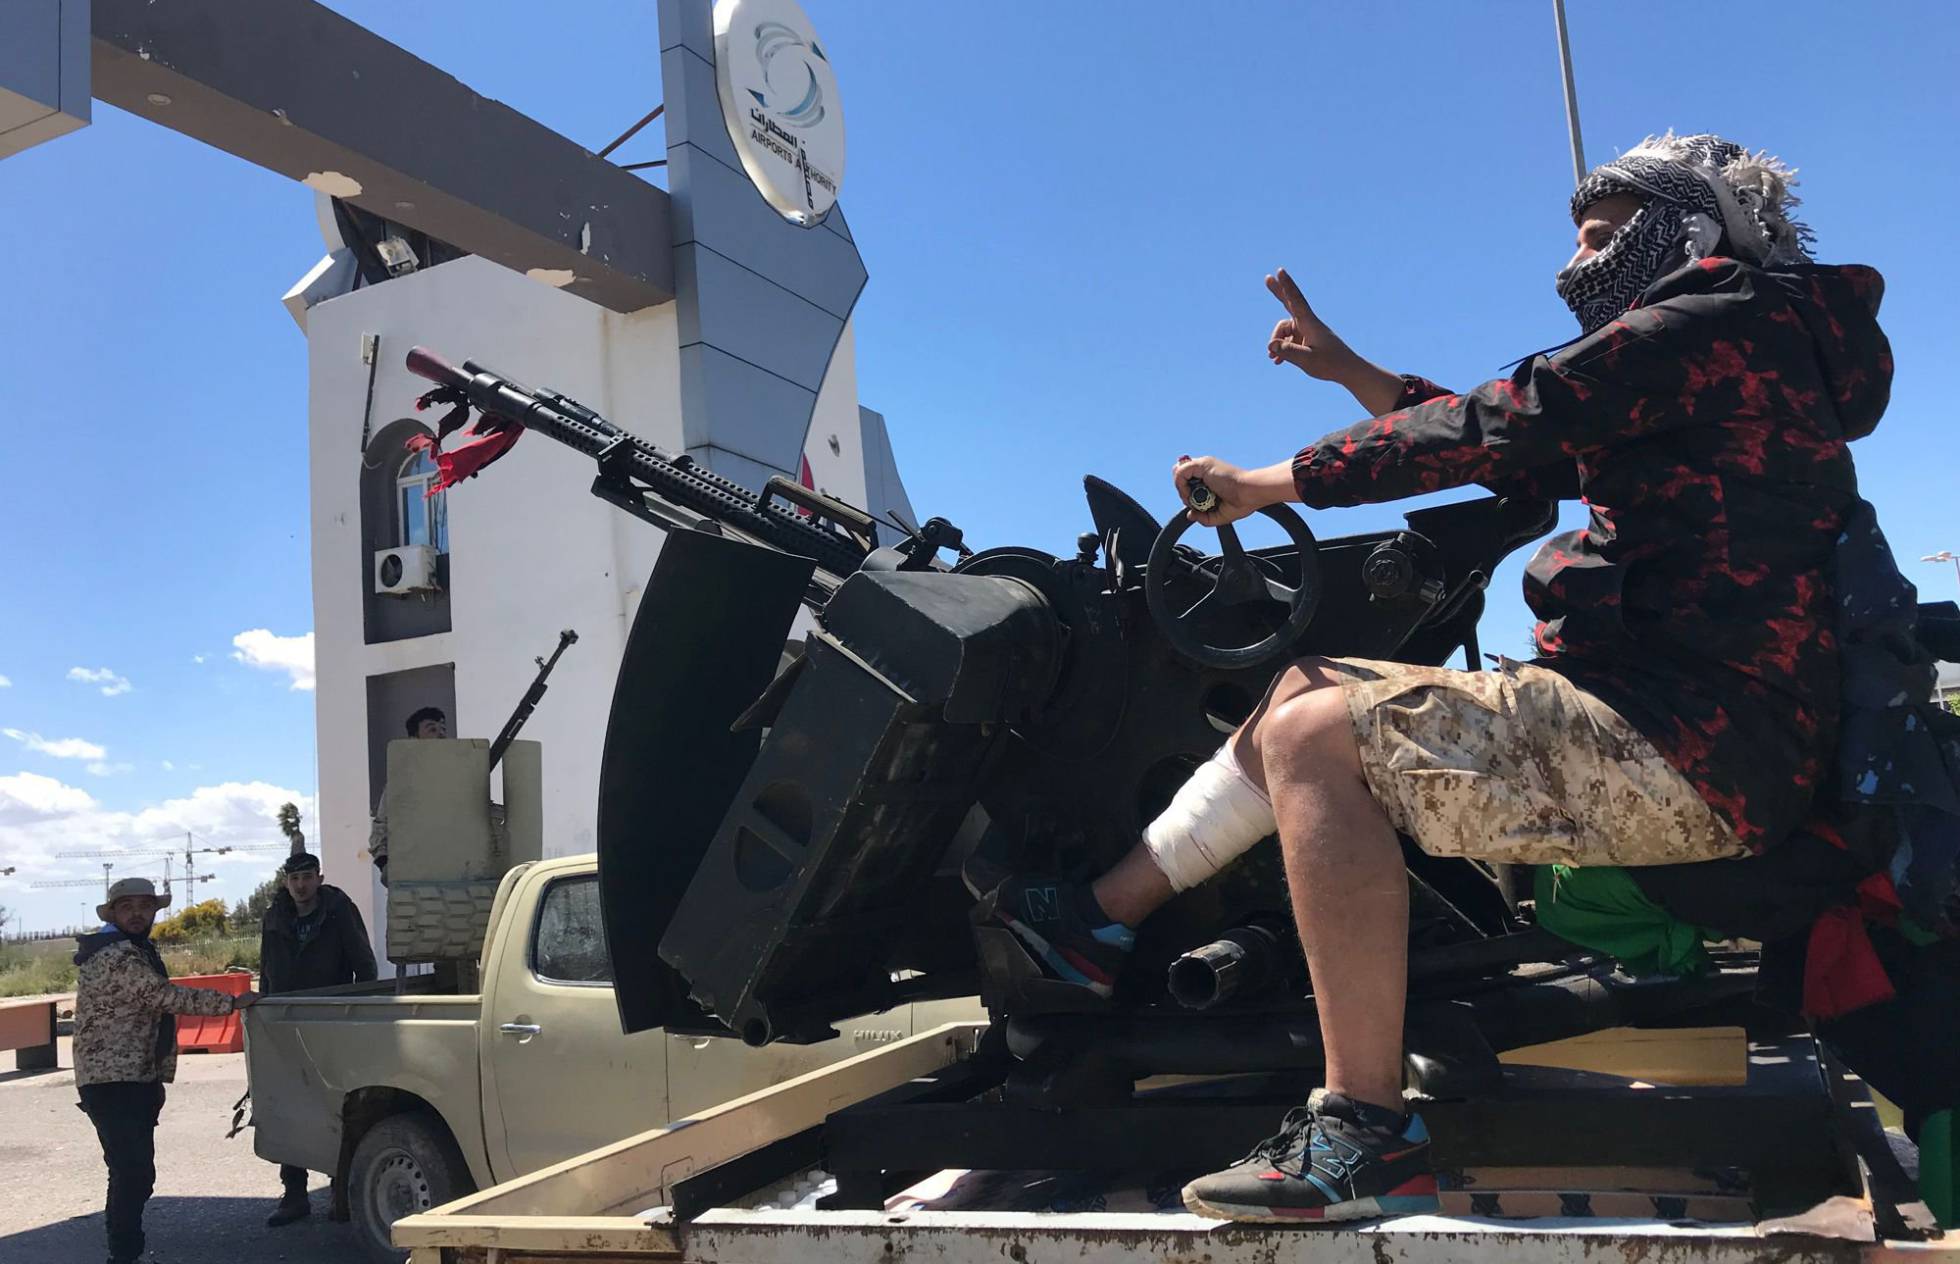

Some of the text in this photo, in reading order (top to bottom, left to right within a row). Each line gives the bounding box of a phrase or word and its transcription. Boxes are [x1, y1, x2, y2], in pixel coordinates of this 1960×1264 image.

[751, 107, 798, 148] المطارات
[751, 129, 837, 195] AIRPORTS AHORITY
[853, 1030, 904, 1042] HILUX
